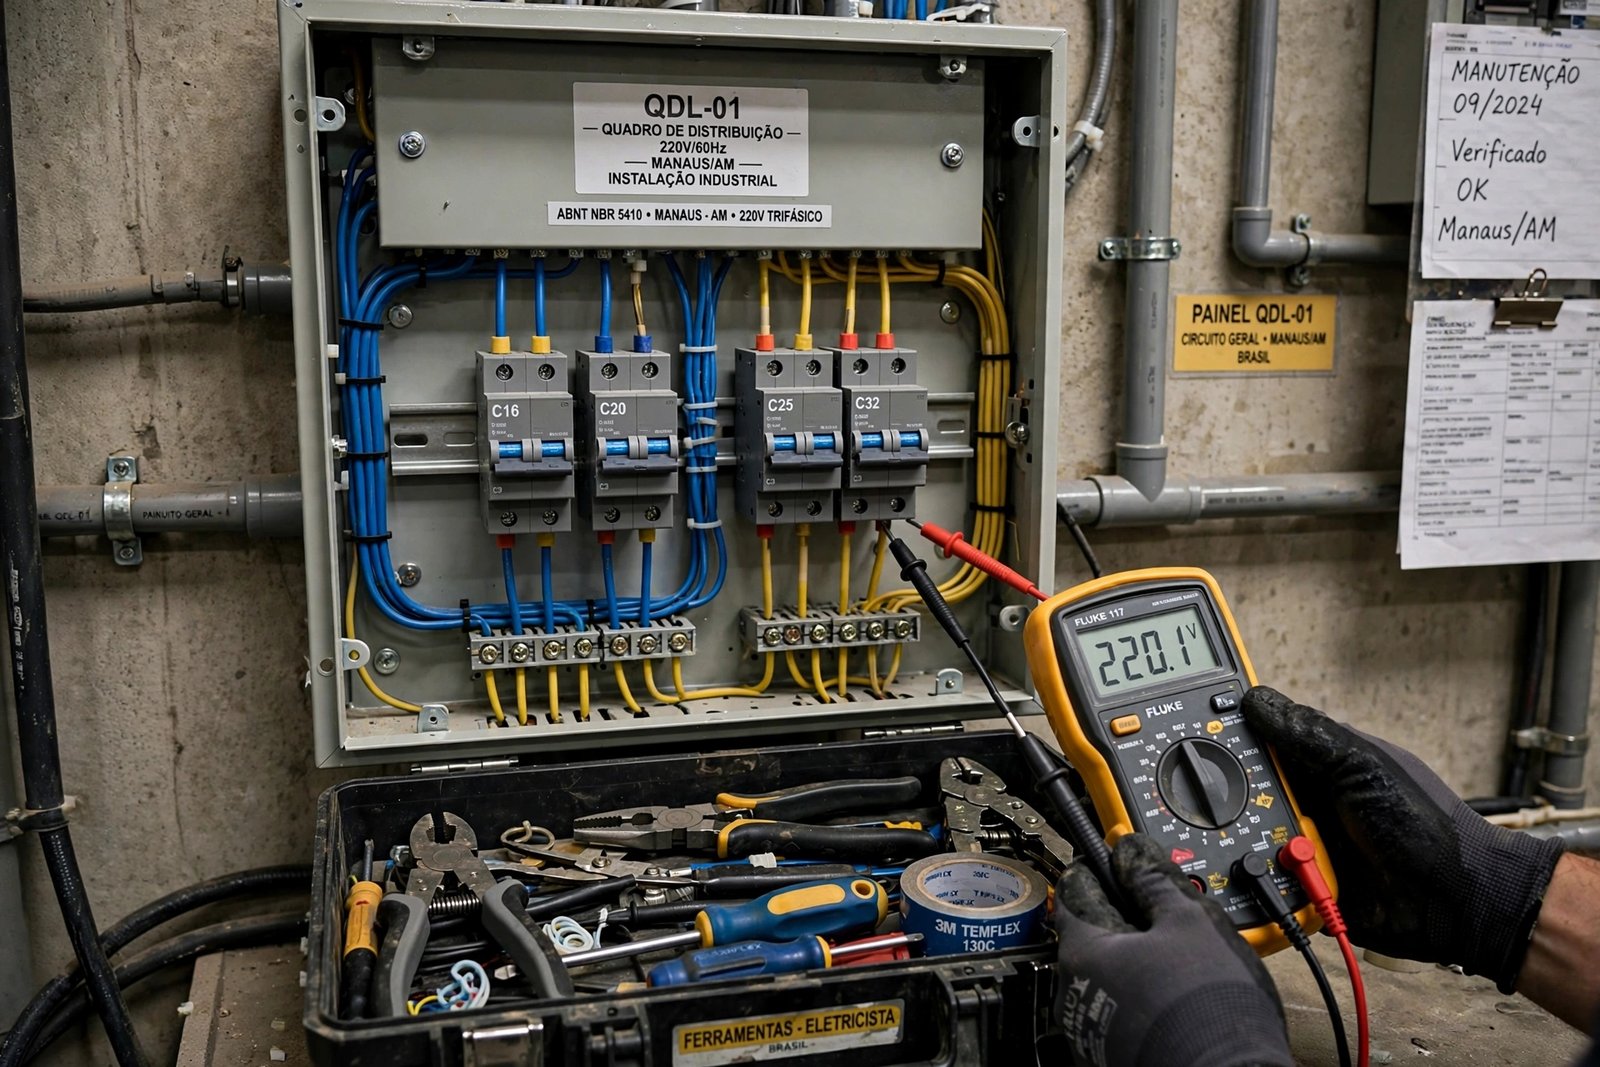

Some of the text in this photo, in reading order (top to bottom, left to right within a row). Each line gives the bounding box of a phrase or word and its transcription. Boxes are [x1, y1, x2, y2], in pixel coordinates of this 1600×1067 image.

[1451, 58, 1580, 90] MANUTENÇÃO
[644, 94, 740, 119] QDL-01
[1453, 88, 1543, 121] 09/2024
[602, 123, 783, 141] QUADRO DE DISTRIBUIÇÃO
[660, 141, 727, 154] 220V/60Hz
[1452, 137, 1547, 168] Verificado
[651, 157, 735, 170] MANAUS/AM
[608, 171, 777, 188] INSTALAÇÃO INDUSTRIAL
[1457, 177, 1489, 202] OK
[557, 208, 588, 220] ABNT
[591, 208, 615, 220] NBR
[618, 208, 642, 220] 5410
[654, 208, 702, 221] MANAUS
[711, 209, 727, 221] AM
[739, 209, 765, 222] 220V
[767, 207, 823, 222] TRIFÁSICO
[1438, 211, 1556, 246] Manaus/AM
[1192, 304, 1313, 324] PAINEL QDL-01
[1181, 333, 1226, 345] CIRCUITO
[1229, 333, 1259, 345] GERAL
[1237, 351, 1270, 363] BRASIL
[492, 404, 519, 418] C16
[600, 402, 626, 415] C20
[768, 398, 794, 412] C25
[855, 396, 880, 410] C32
[1074, 607, 1125, 627] FLUKE 117
[1095, 623, 1197, 687] 220.1 V
[1145, 700, 1183, 718] FLUKE
[935, 918, 1021, 938] 3M TEMFLEX
[963, 940, 995, 952] 130C
[683, 1022, 794, 1051] FERRAMENTAS
[806, 1009, 896, 1034] ELETRICISTA
[768, 1040, 808, 1054] BRASIL
